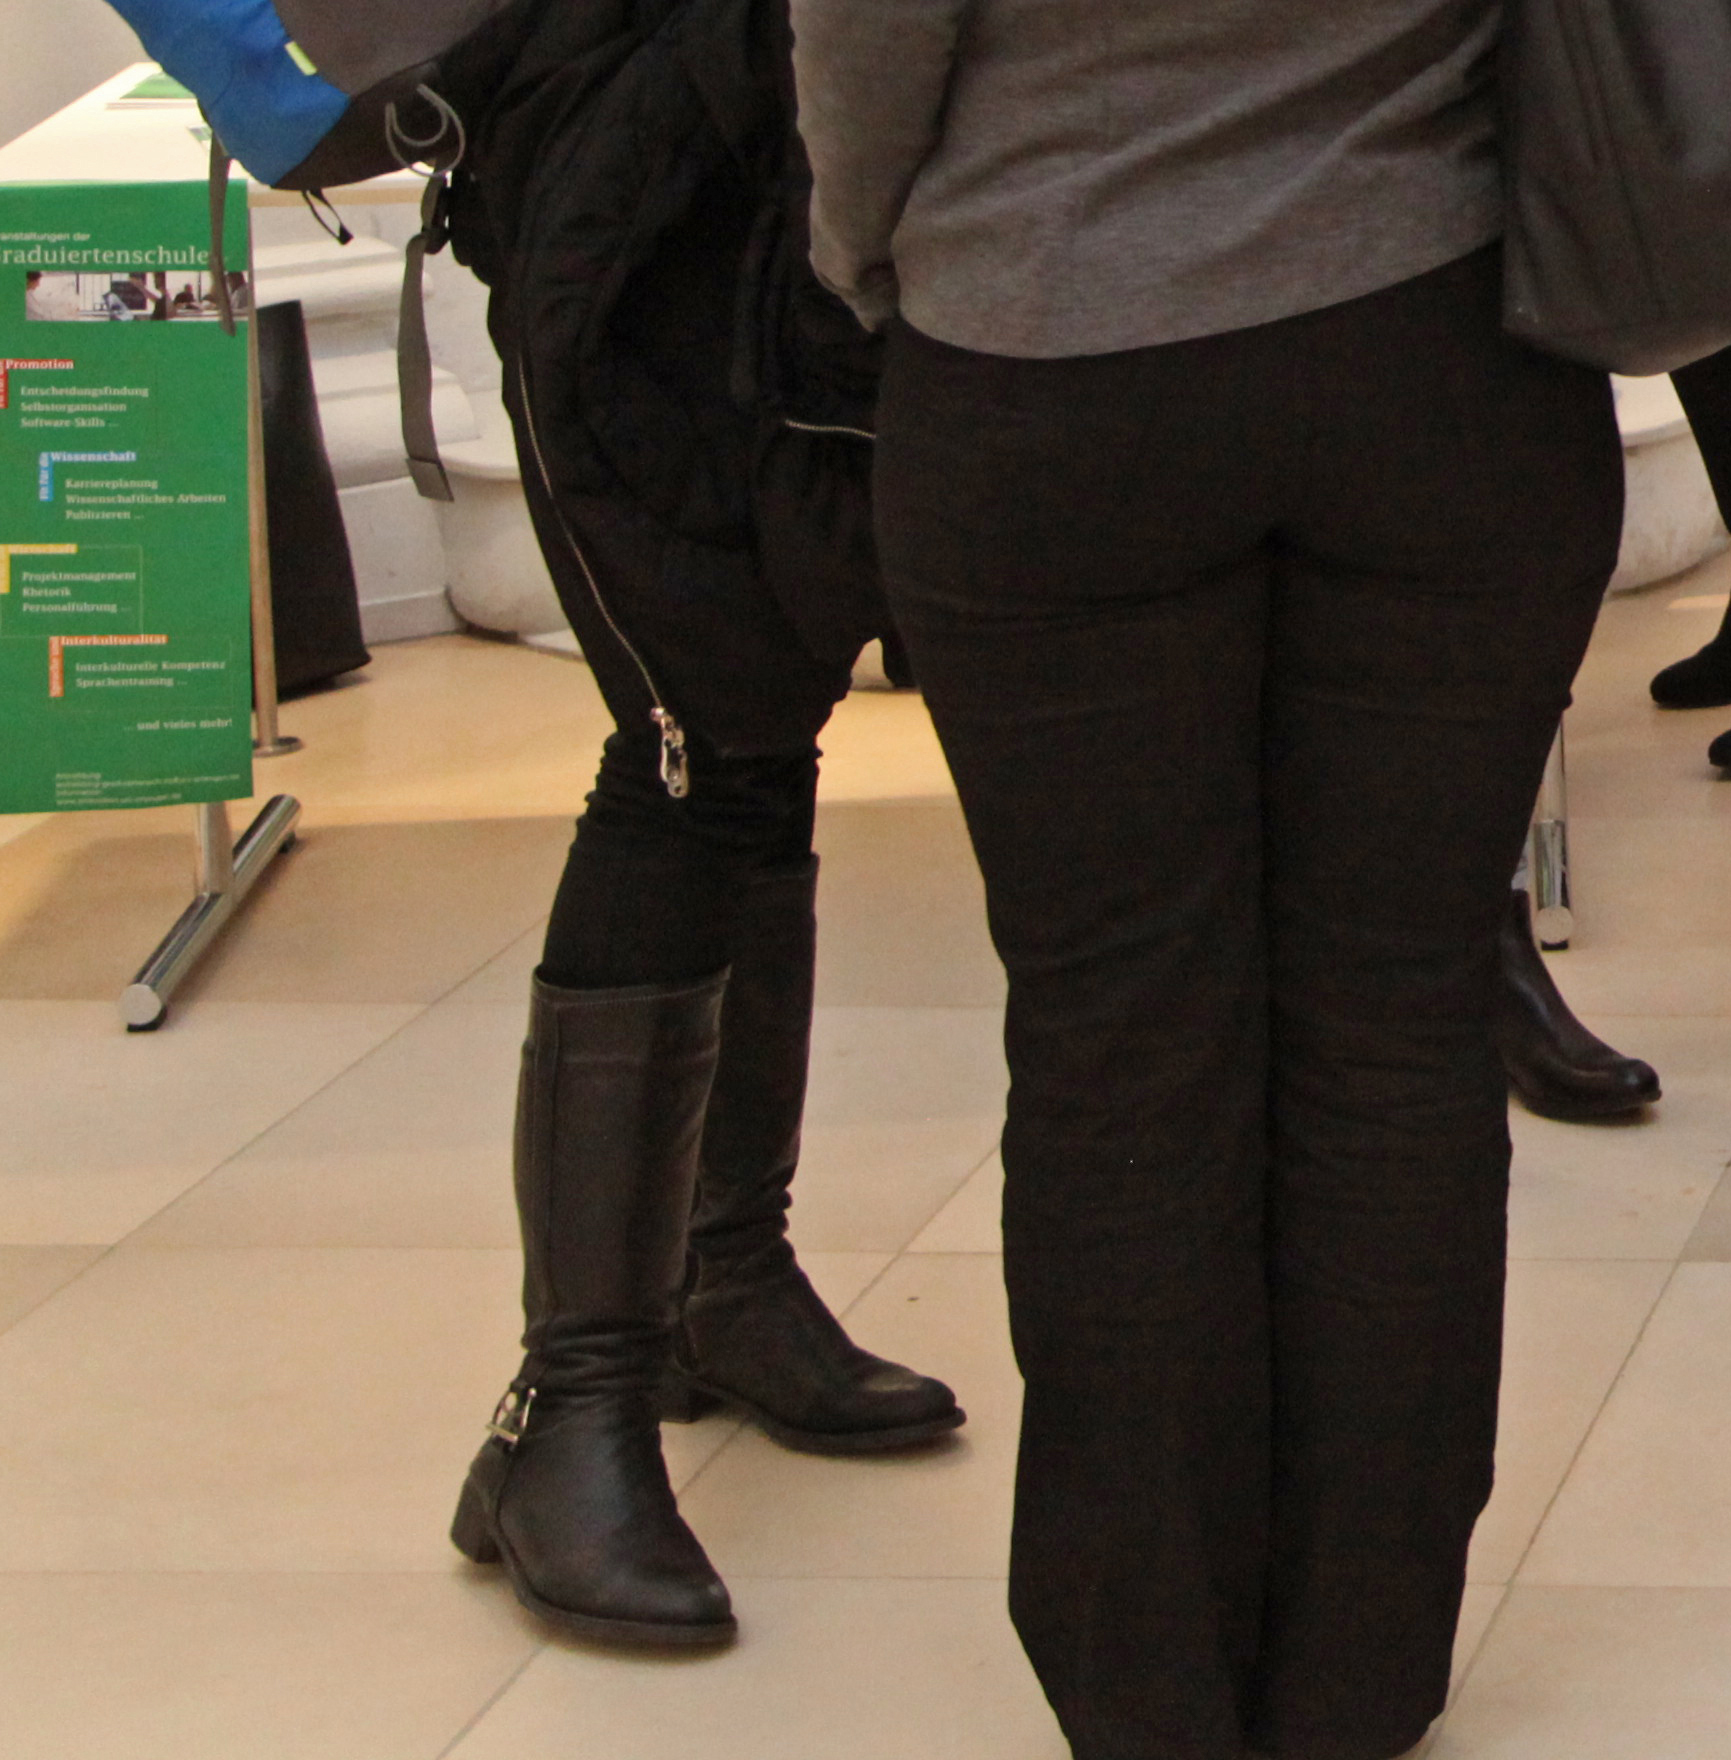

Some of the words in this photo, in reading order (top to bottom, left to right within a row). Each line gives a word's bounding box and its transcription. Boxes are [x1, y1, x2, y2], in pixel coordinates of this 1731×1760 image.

[0, 245, 210, 265] raduiertenschule
[6, 359, 74, 369] Promotion
[21, 386, 149, 398] Entscheidungsfindung
[51, 451, 136, 461] Wissenschaft
[65, 479, 158, 490] Karriereplanung
[65, 494, 173, 504] Wissenschaftliches
[22, 572, 136, 583] Projektmanagement
[137, 721, 160, 731] und
